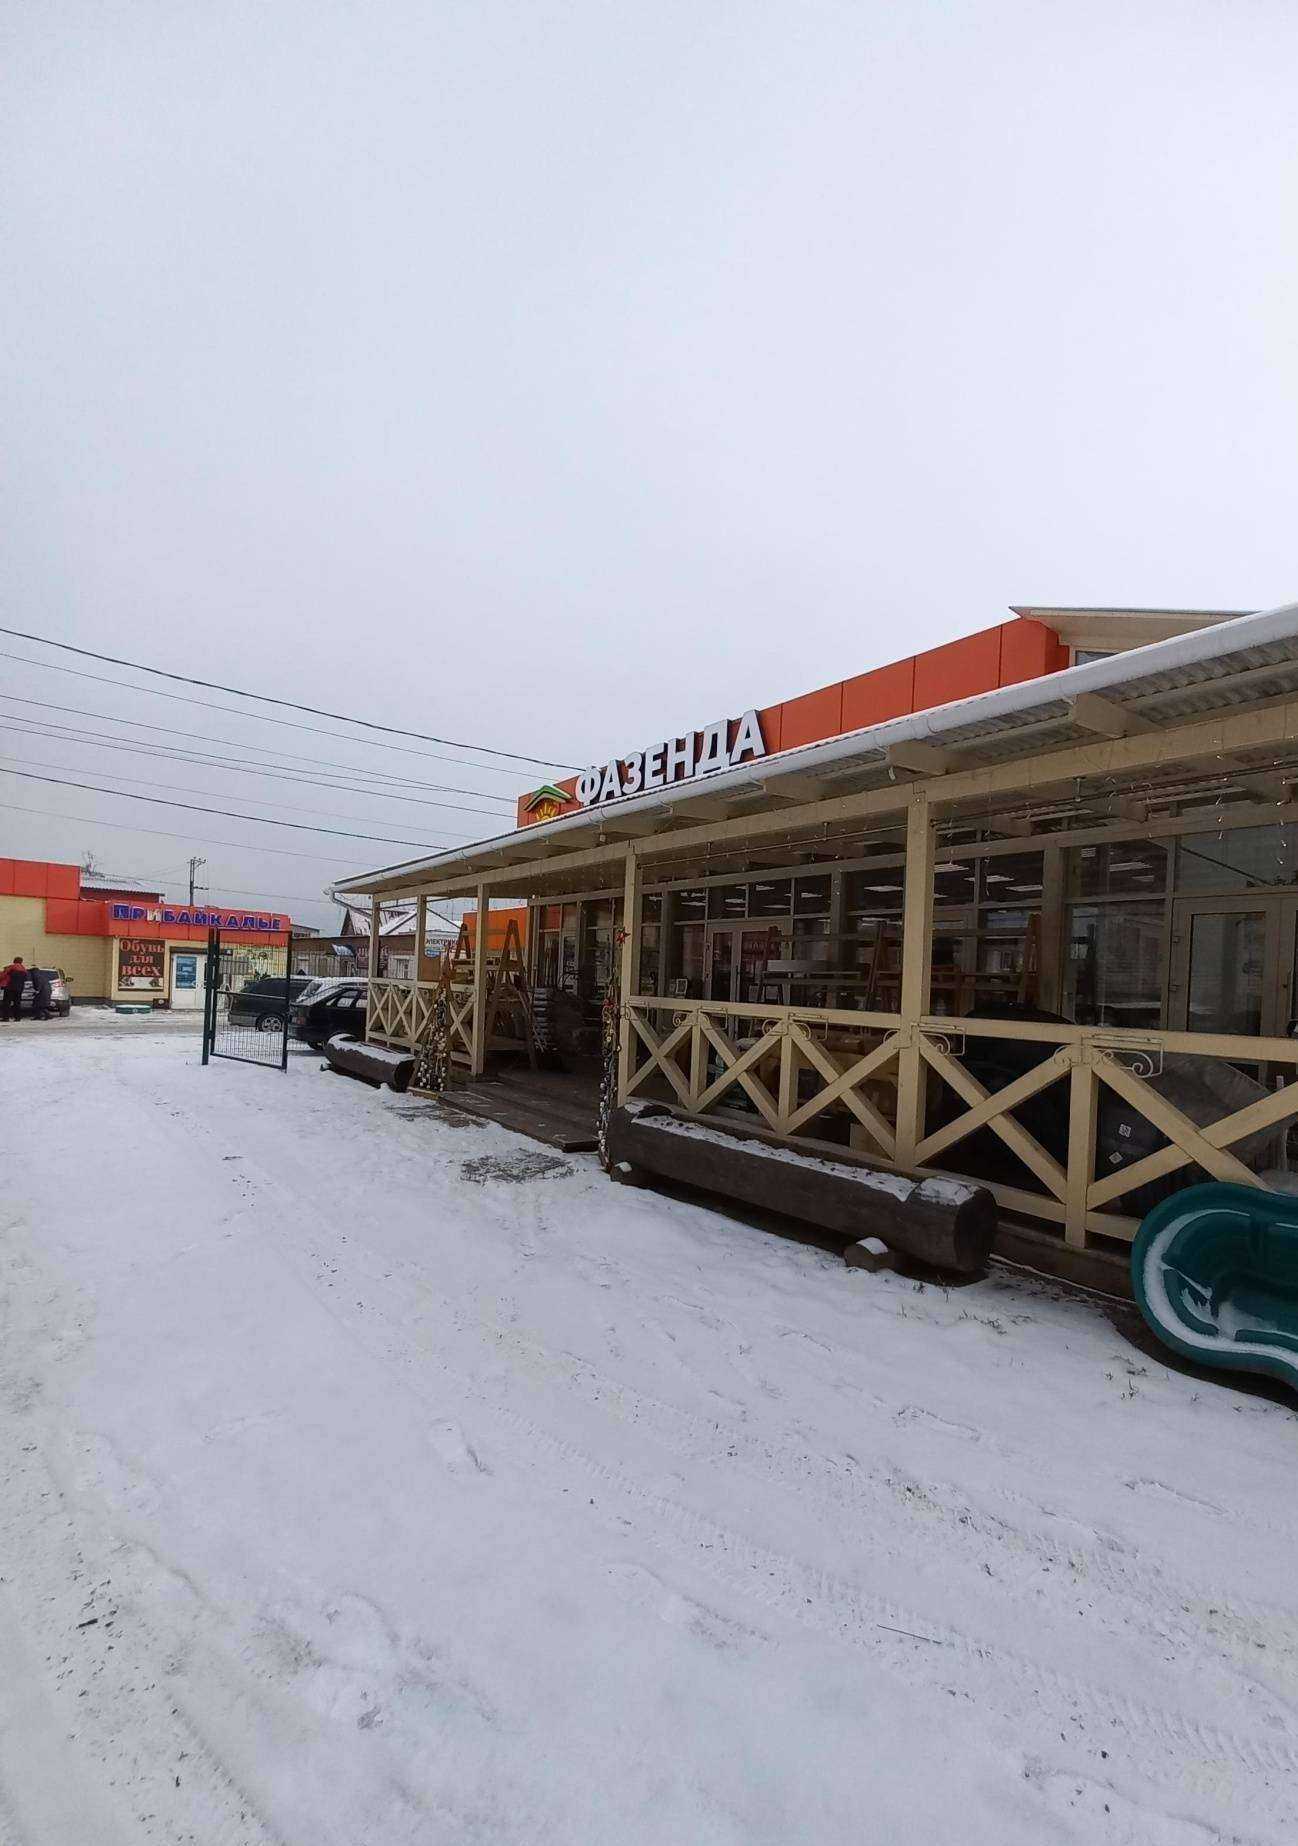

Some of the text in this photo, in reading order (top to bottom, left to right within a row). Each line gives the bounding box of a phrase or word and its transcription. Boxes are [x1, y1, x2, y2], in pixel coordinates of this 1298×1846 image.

[575, 708, 766, 807] ФАЗЕНДА
[112, 903, 281, 930] ПРИБАЙКАЛЬЕ
[120, 939, 165, 955] Обувь
[130, 955, 153, 965] для
[122, 965, 161, 976] всех
